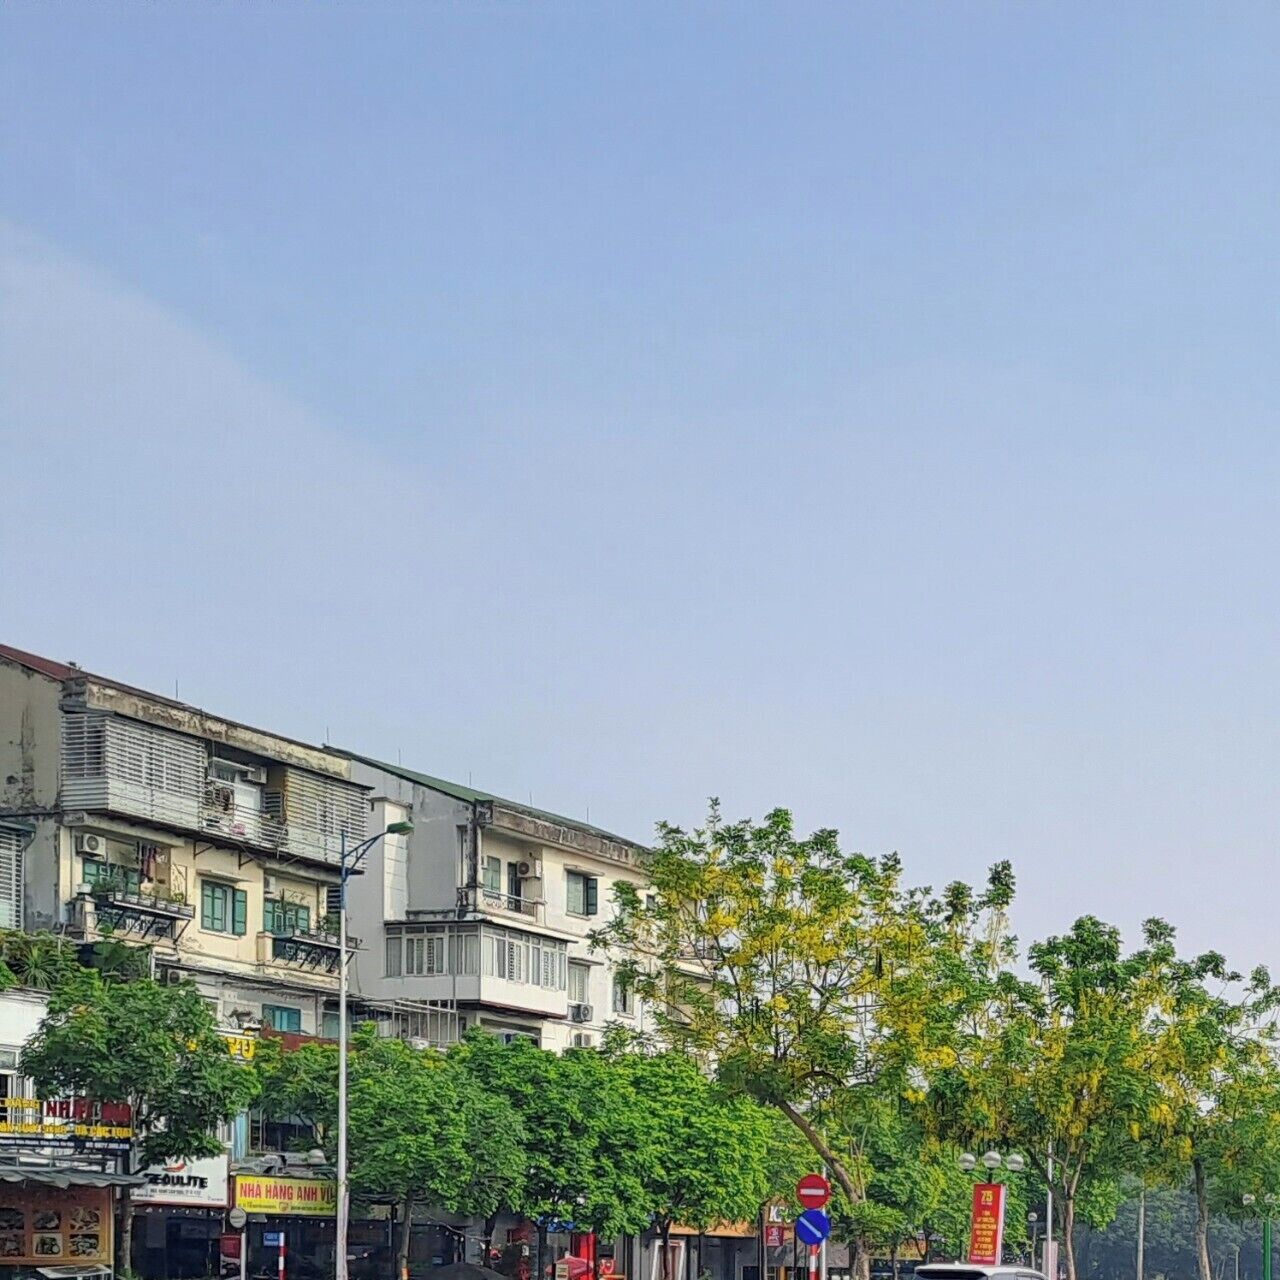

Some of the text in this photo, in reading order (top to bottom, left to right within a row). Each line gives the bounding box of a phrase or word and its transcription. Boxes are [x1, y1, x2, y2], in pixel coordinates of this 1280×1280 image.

[240, 1181, 261, 1198] NHÀ
[265, 1181, 293, 1200] HÀNG
[297, 1186, 317, 1201] ANH
